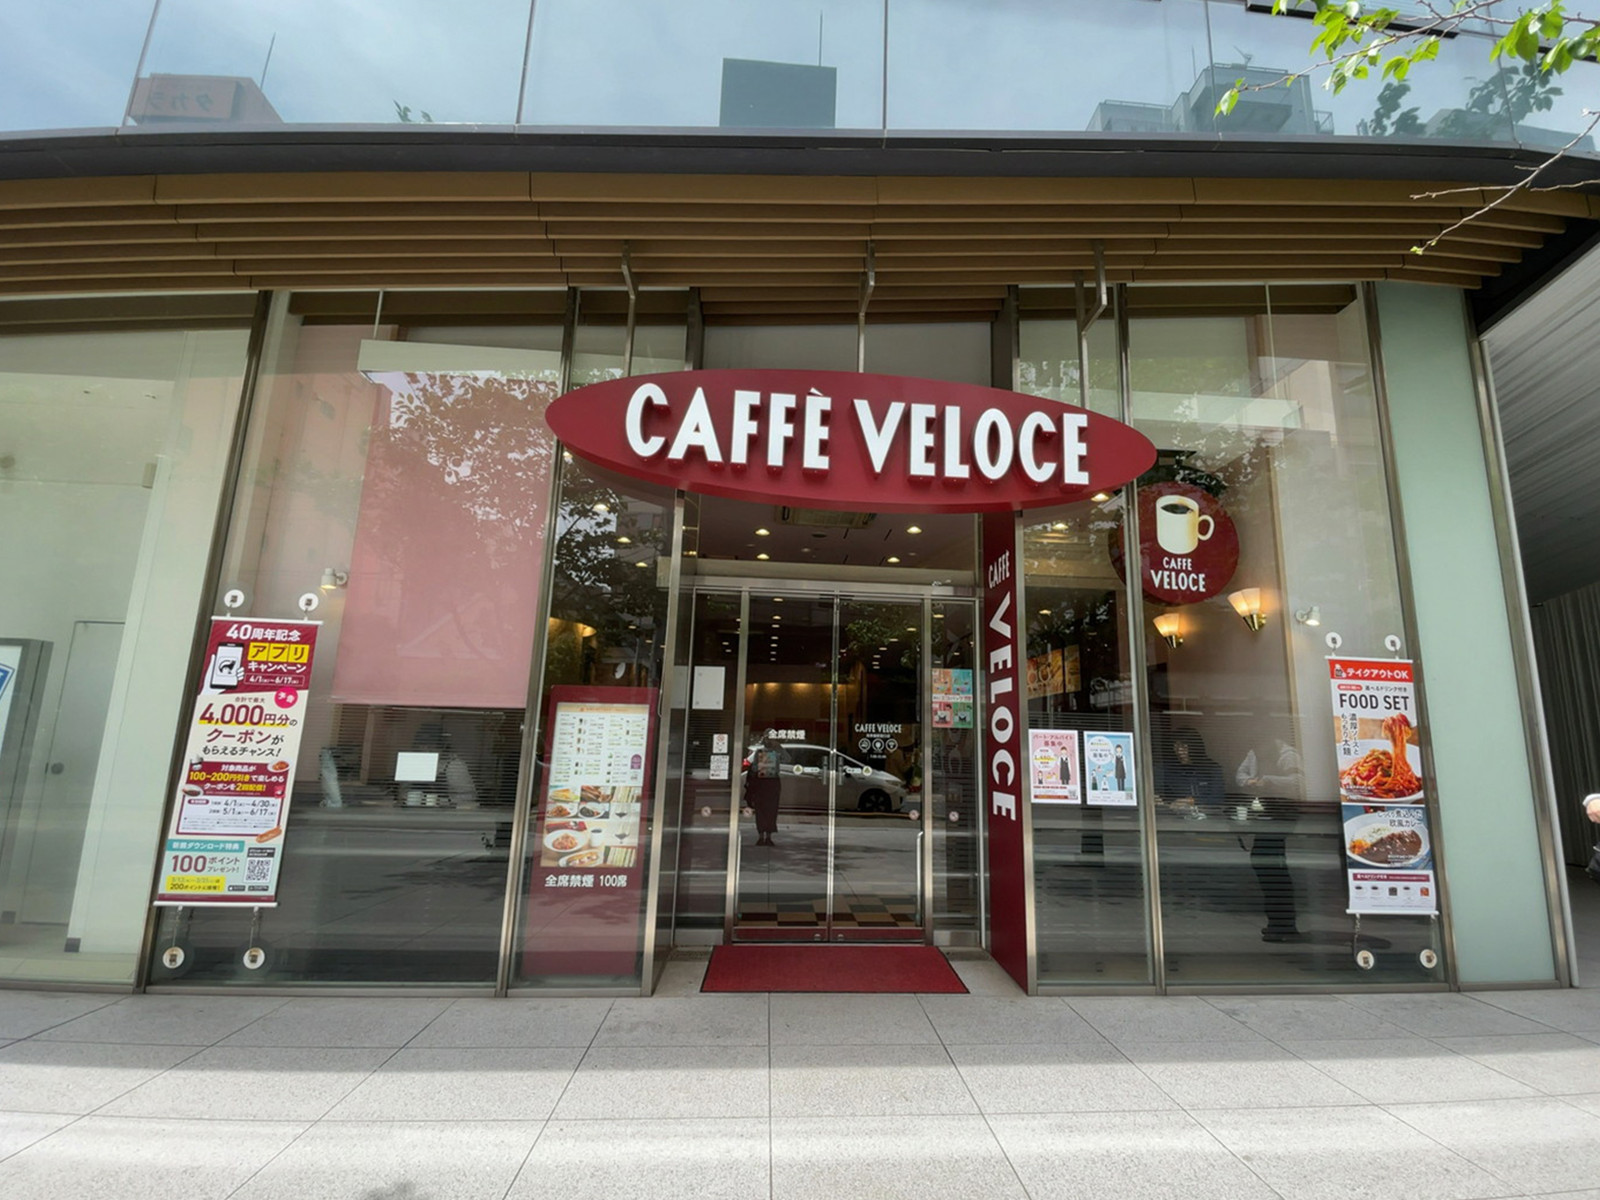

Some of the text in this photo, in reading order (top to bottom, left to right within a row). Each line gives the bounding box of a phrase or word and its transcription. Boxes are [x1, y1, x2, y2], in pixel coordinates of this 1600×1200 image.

[625, 382, 1090, 485] CAFFÈ VELOCE
[1150, 569, 1206, 592] VELOCE
[226, 624, 302, 642] 40周年記念
[250, 644, 306, 661] アプリ
[248, 662, 307, 673] キャンペーン
[1347, 668, 1409, 679] テイクアウトOK
[989, 591, 1017, 821] VELOCE
[1339, 693, 1410, 711] FOOD SET
[200, 703, 298, 726] 4,000円分の
[206, 728, 284, 745] クーポンが
[768, 729, 806, 740] 全席禁煙
[877, 724, 902, 733] VELOCE
[172, 854, 207, 873] 100
[208, 857, 240, 866] ポイント
[544, 874, 628, 888] 全席禁煙 100席
